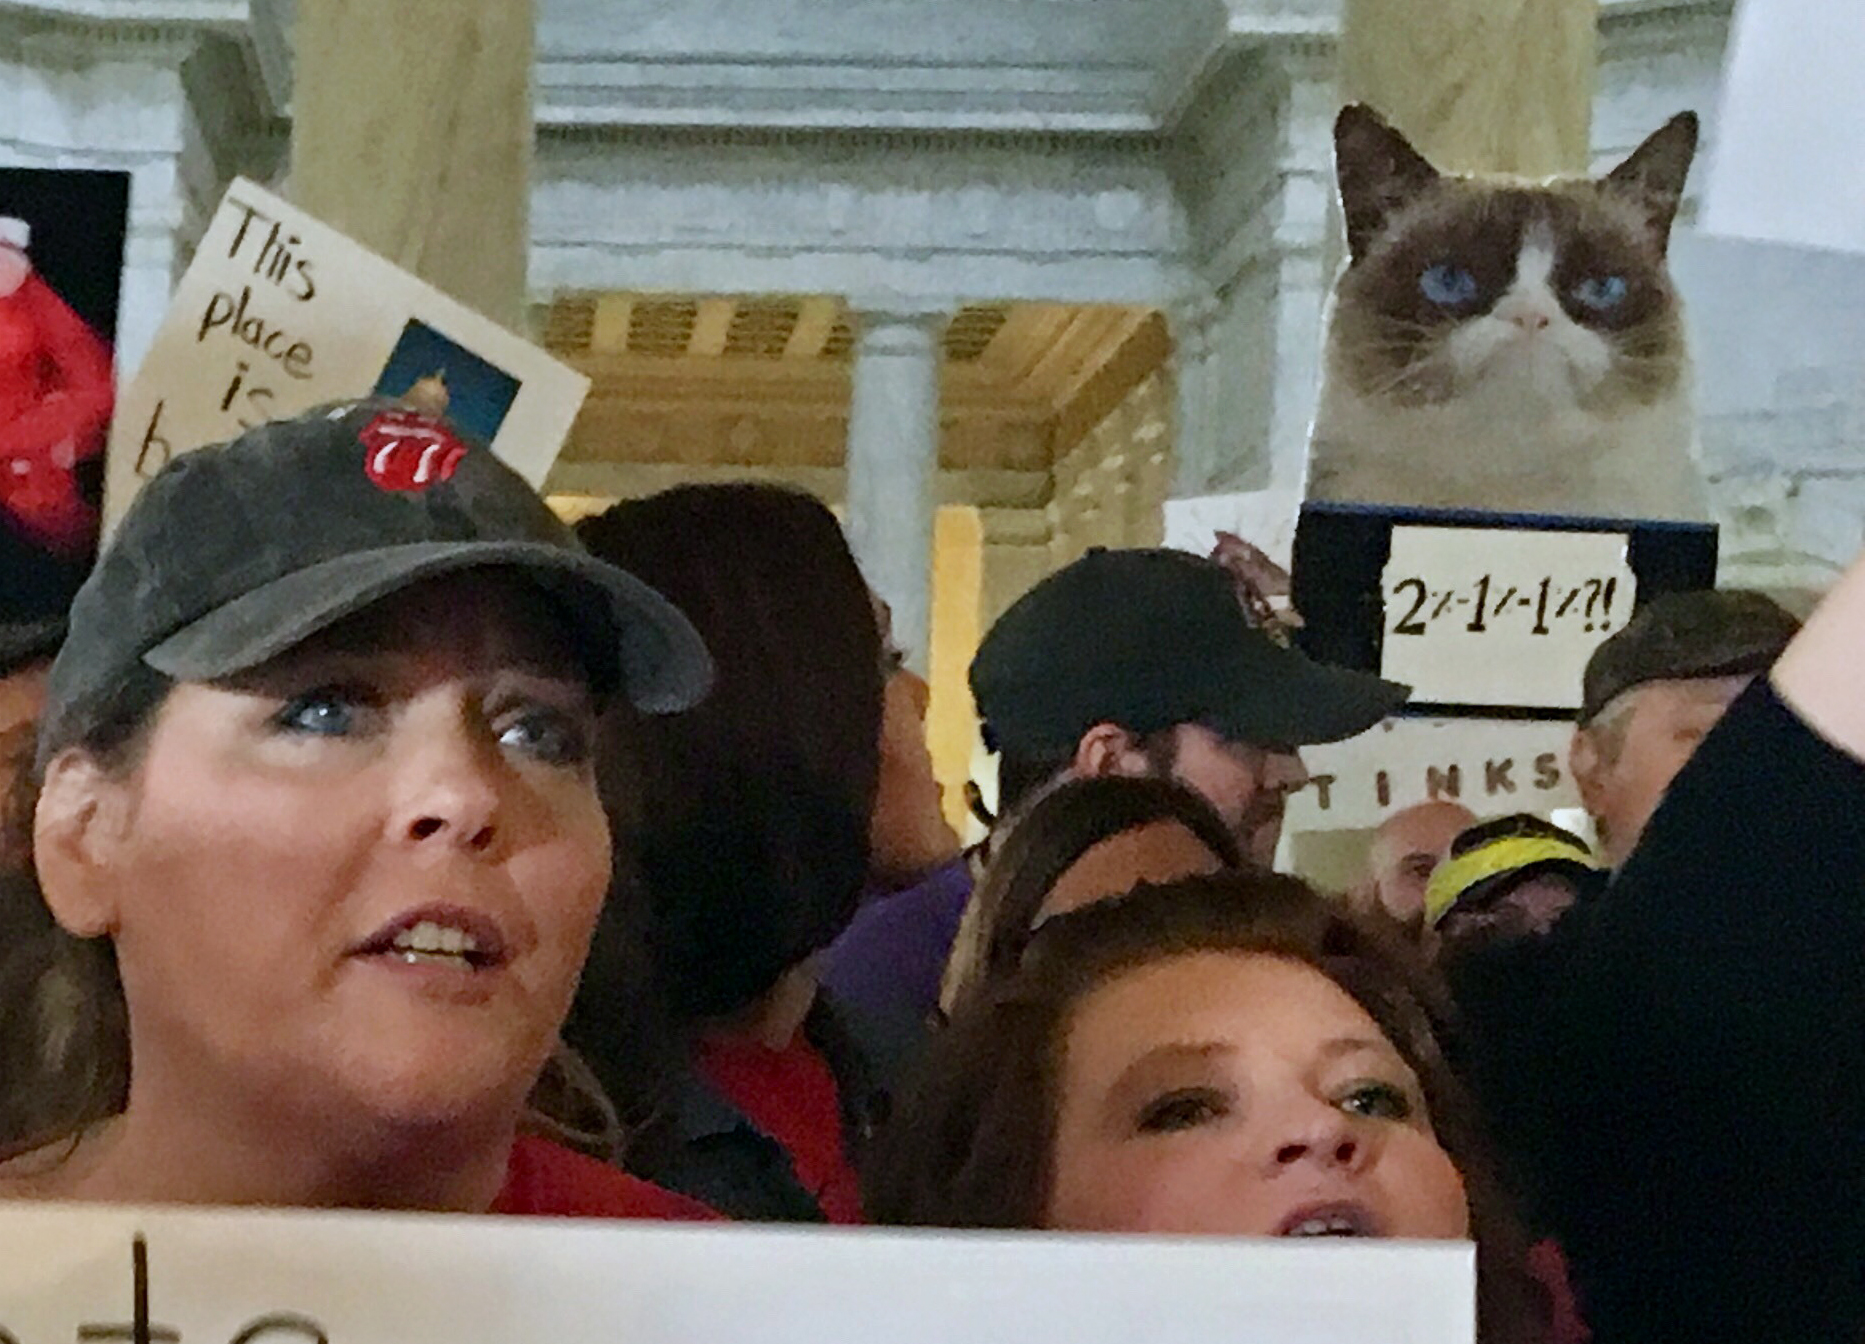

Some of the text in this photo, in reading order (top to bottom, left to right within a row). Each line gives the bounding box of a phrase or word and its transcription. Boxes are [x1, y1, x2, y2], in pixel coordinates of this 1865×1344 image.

[229, 197, 315, 301] This
[197, 286, 313, 379] place
[1308, 752, 1560, 810] TINKS
